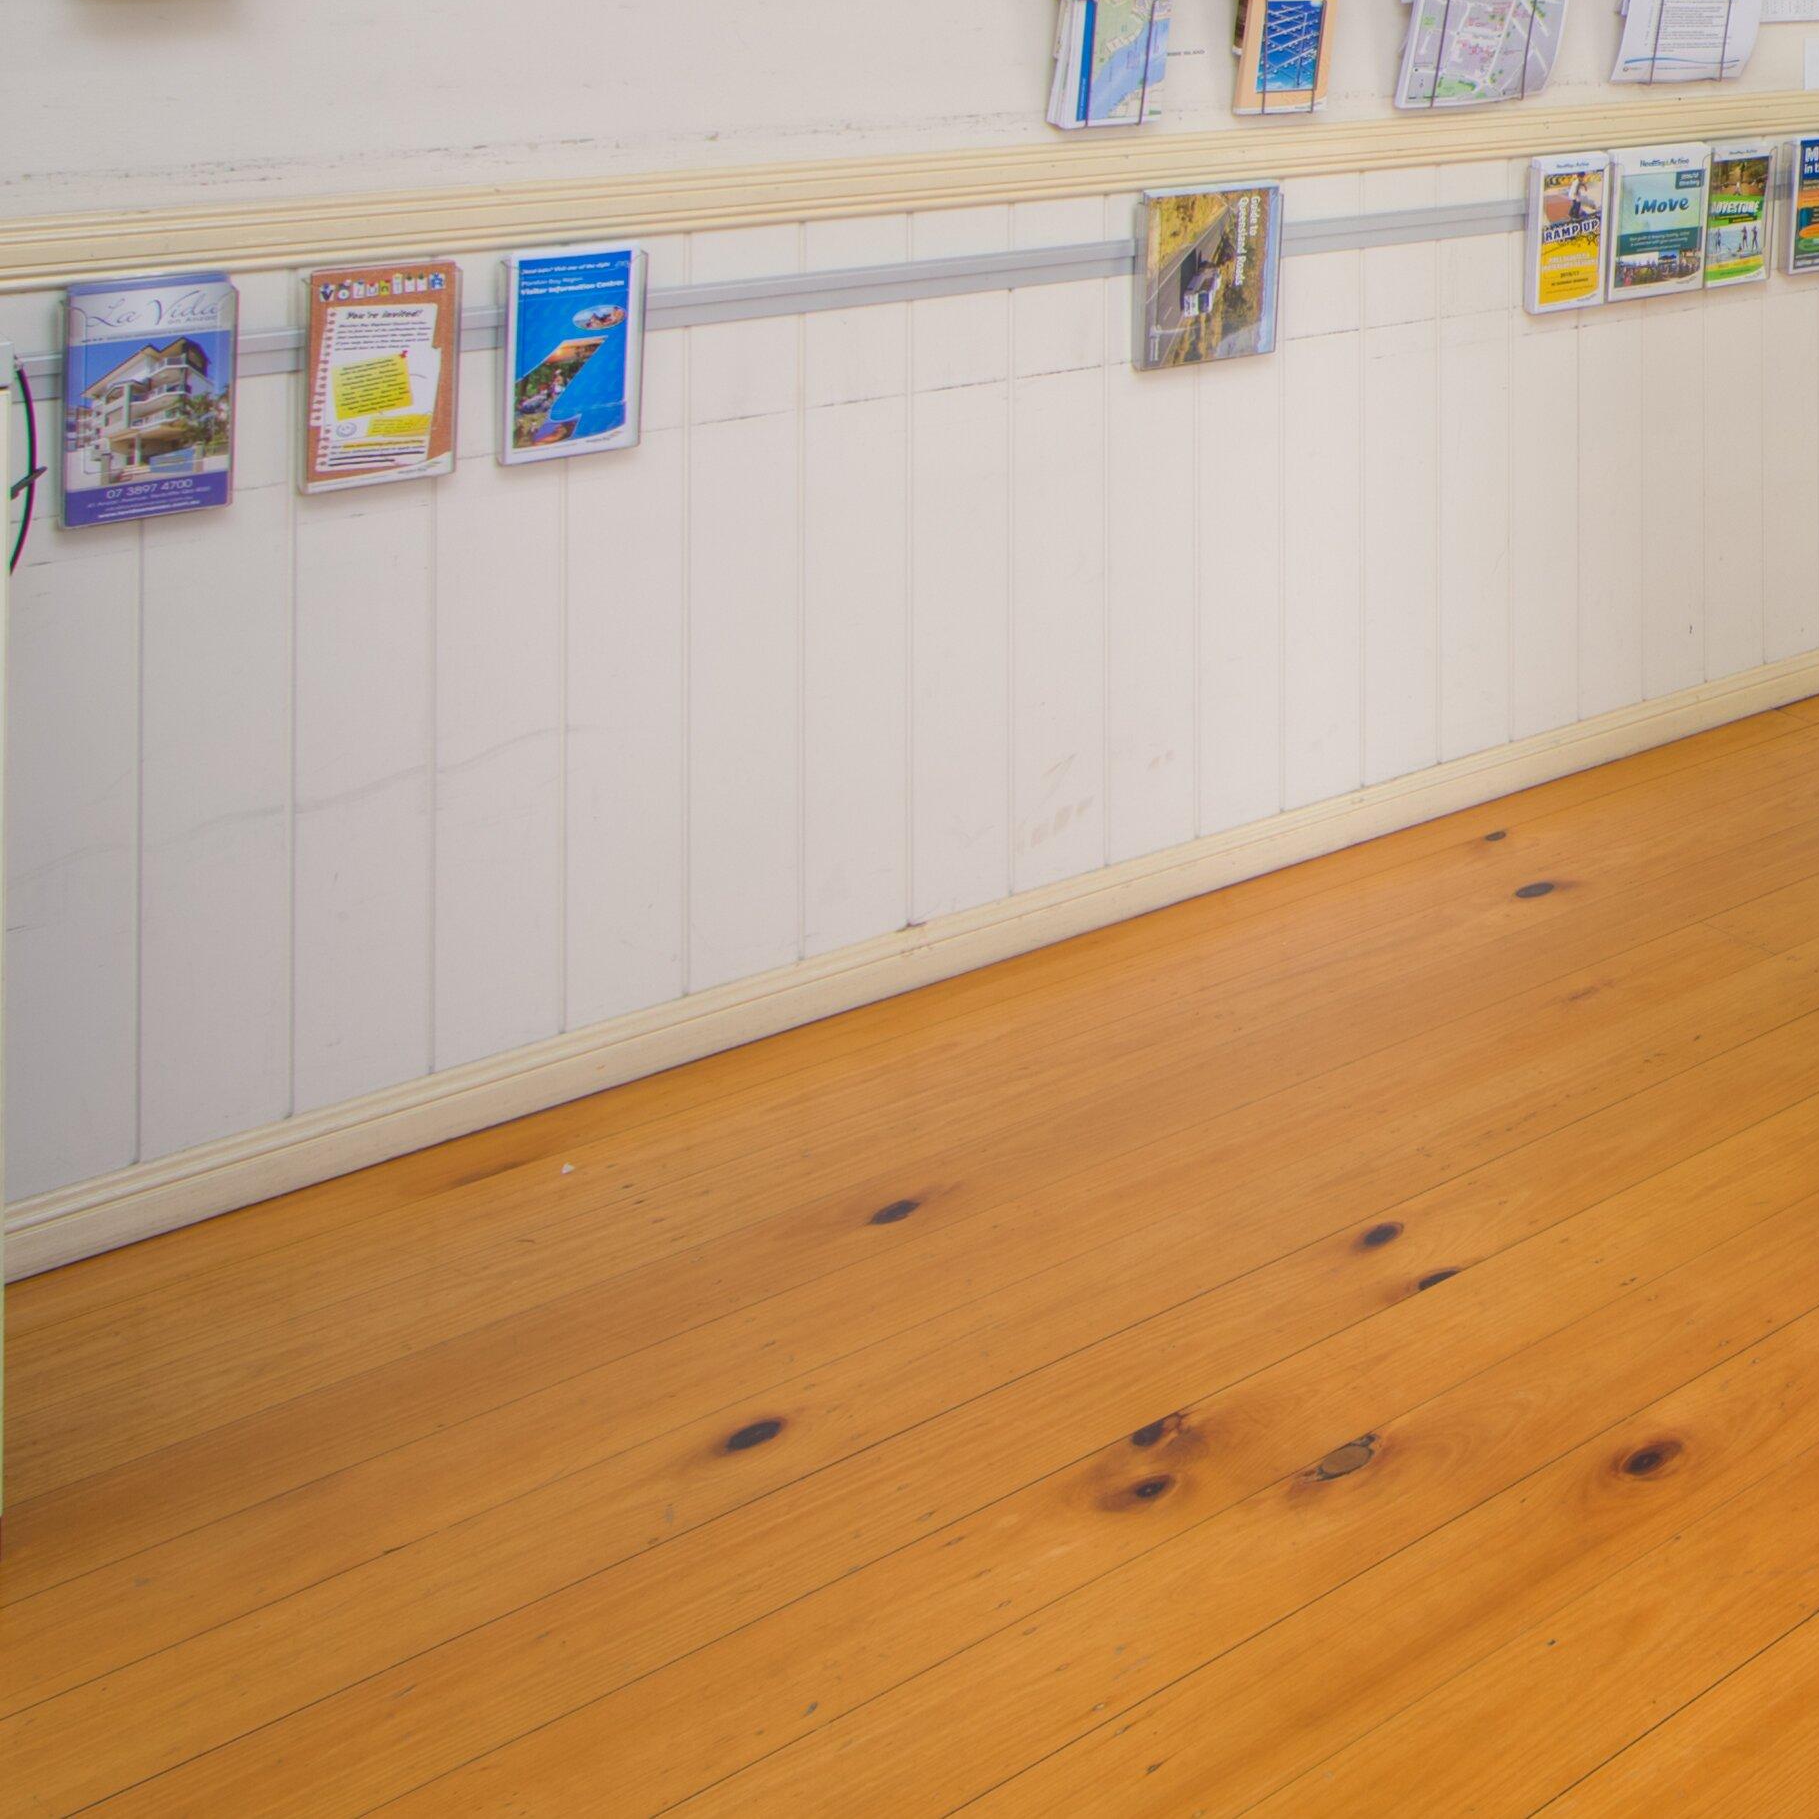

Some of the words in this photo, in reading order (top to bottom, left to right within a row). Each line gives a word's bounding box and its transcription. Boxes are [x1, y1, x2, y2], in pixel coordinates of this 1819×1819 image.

[1804, 164, 1813, 175] in
[1250, 195, 1261, 225] Guide
[1634, 196, 1689, 216] iMove
[1237, 195, 1250, 254] Queensland
[1250, 226, 1259, 237] to
[1544, 224, 1580, 243] RAMP
[1583, 218, 1600, 234] UP
[1235, 254, 1248, 287] Roads
[521, 287, 546, 296] Visitor
[548, 283, 595, 295] Information
[86, 297, 141, 329] La
[150, 290, 228, 326] Vida
[106, 489, 124, 500] 07
[126, 484, 160, 497] 3897
[161, 479, 193, 491] 4700
